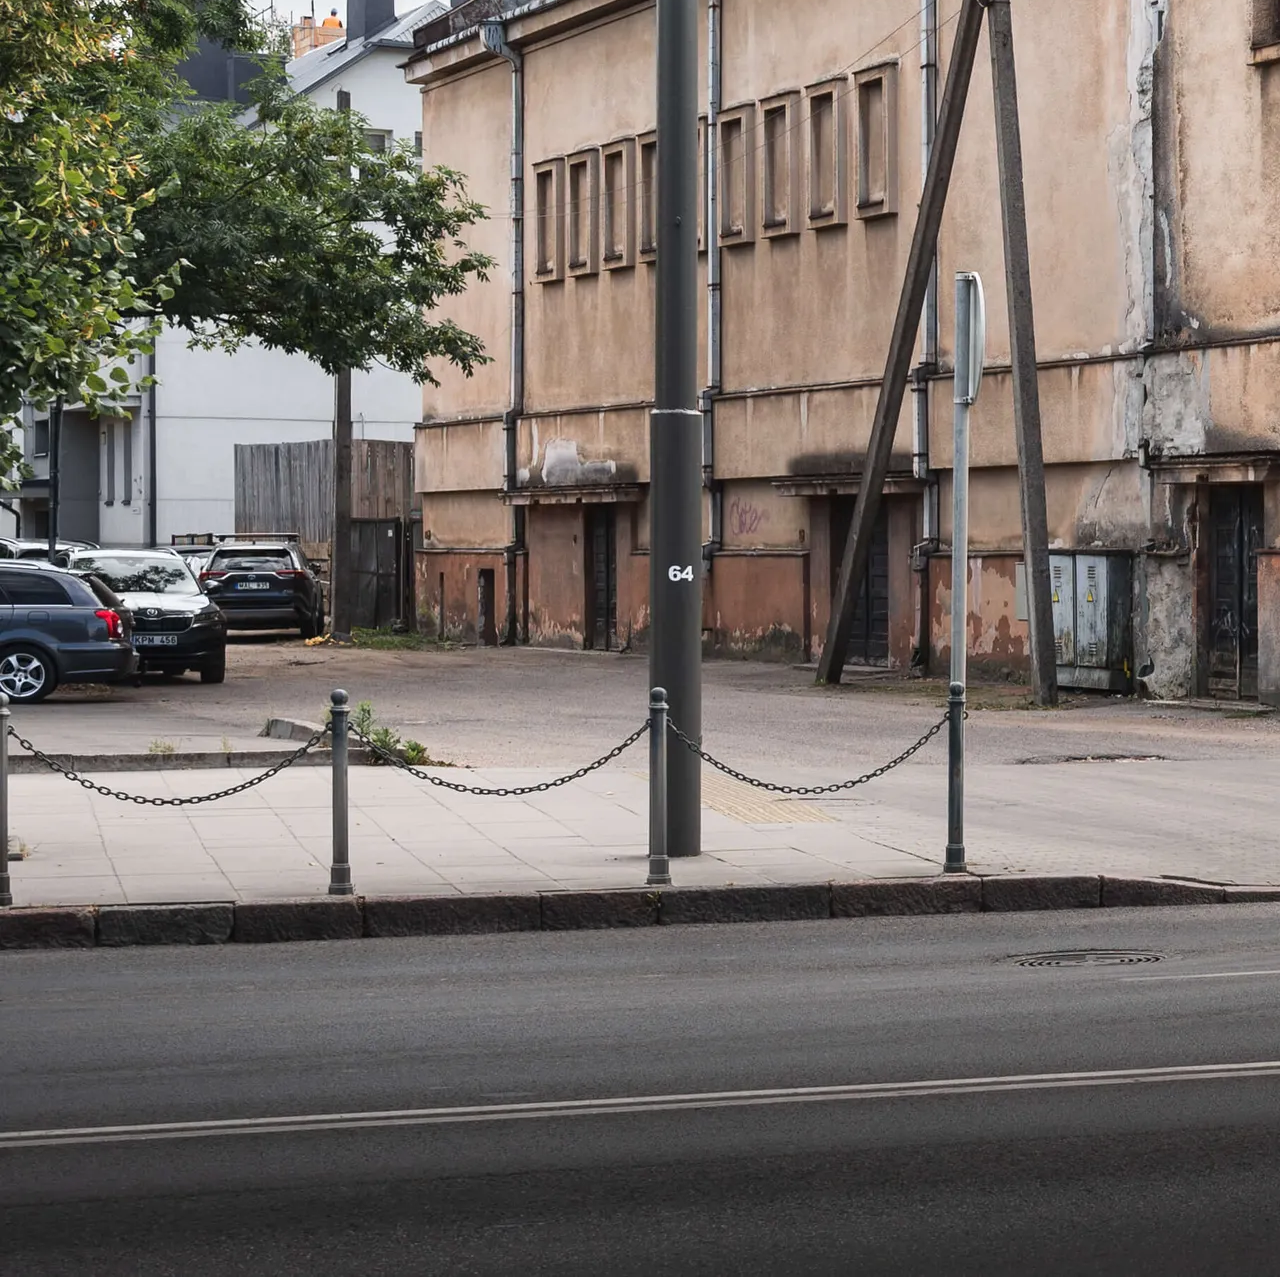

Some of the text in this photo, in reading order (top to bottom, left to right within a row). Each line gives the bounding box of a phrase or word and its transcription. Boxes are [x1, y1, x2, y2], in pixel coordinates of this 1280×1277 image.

[668, 565, 694, 581] 64
[135, 636, 176, 644] KPM 456
